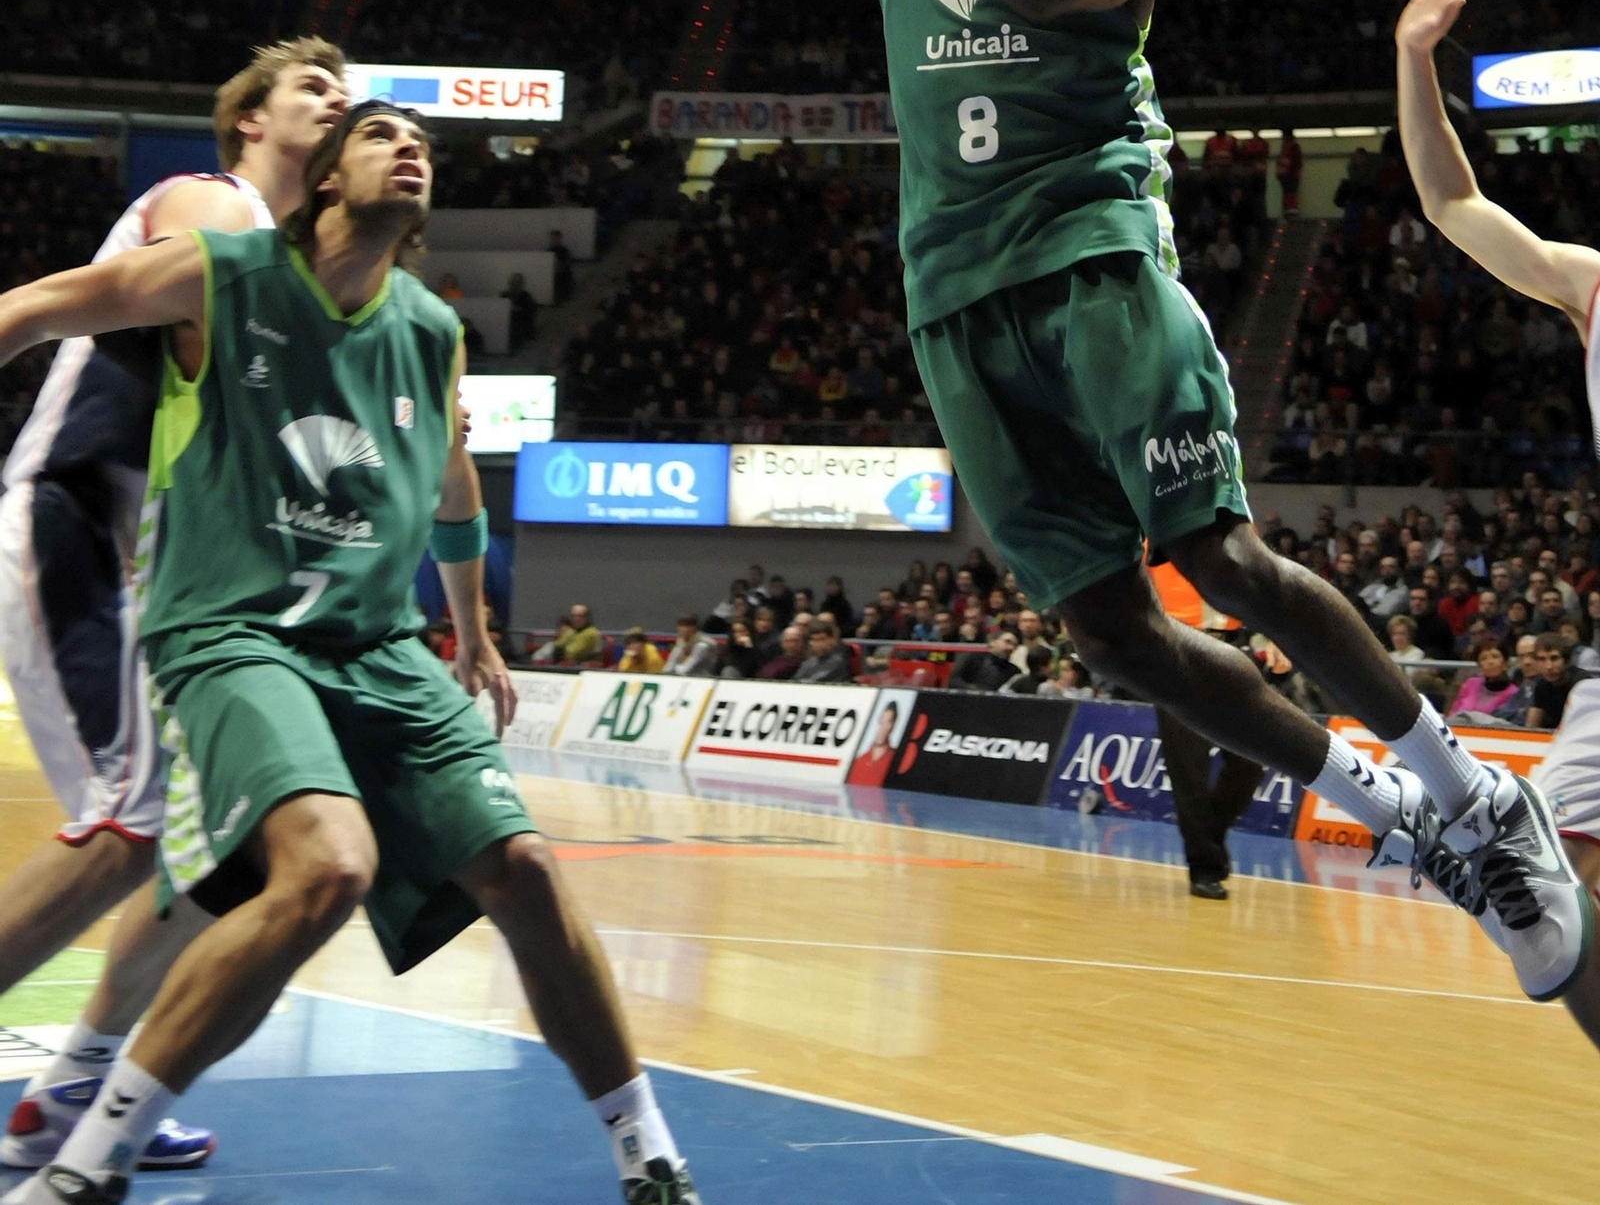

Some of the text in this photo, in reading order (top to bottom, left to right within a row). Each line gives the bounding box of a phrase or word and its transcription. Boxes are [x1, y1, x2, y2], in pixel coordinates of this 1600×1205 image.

[925, 23, 1029, 59] Unicaja
[452, 79, 552, 109] SEUR
[657, 97, 794, 132] BARANDA
[957, 95, 999, 163] 8
[587, 460, 699, 503] IMQ
[764, 451, 897, 477] Boulevard
[279, 571, 330, 627] 7
[741, 703, 857, 747] CORREO
[923, 728, 1050, 763] BASKONIA
